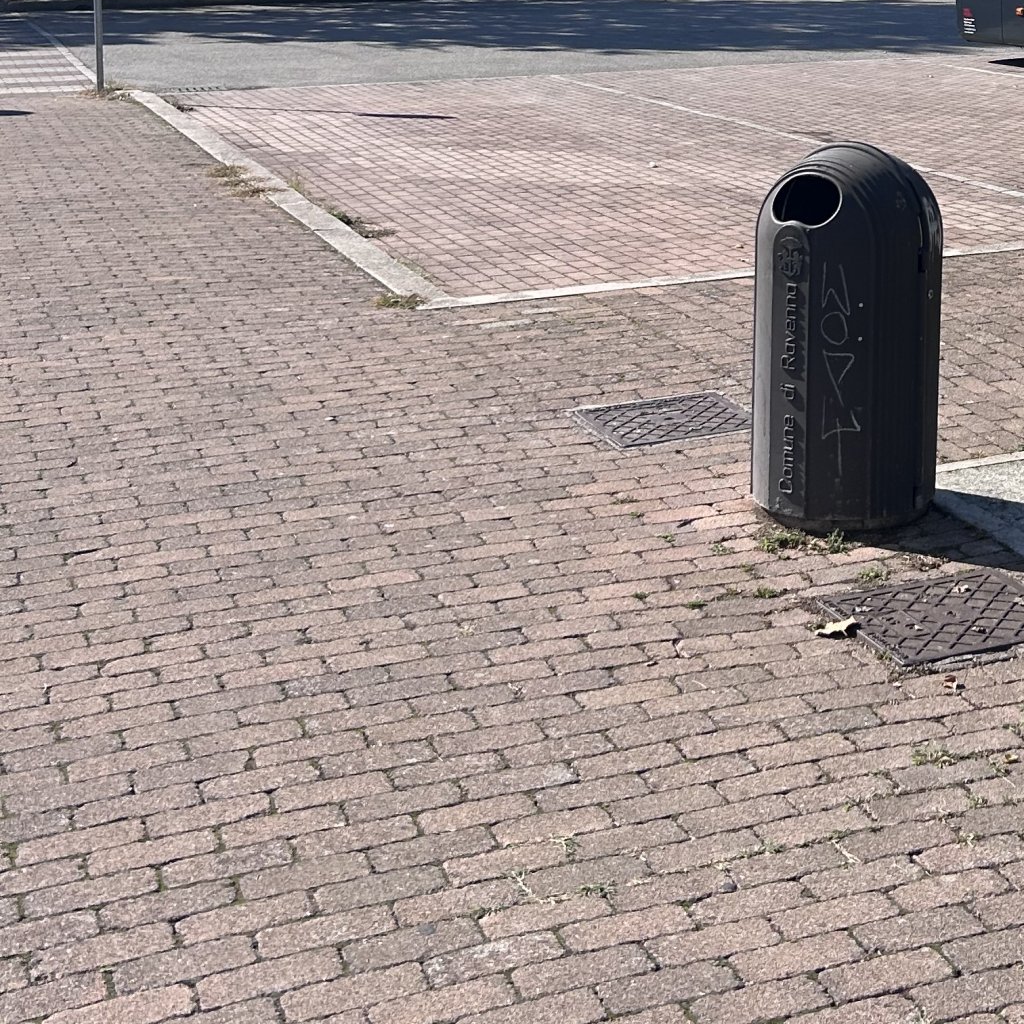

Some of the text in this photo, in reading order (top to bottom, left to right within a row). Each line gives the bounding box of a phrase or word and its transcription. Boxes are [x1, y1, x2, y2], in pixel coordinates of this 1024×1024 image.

[778, 282, 799, 495] Comune di Ravenna
